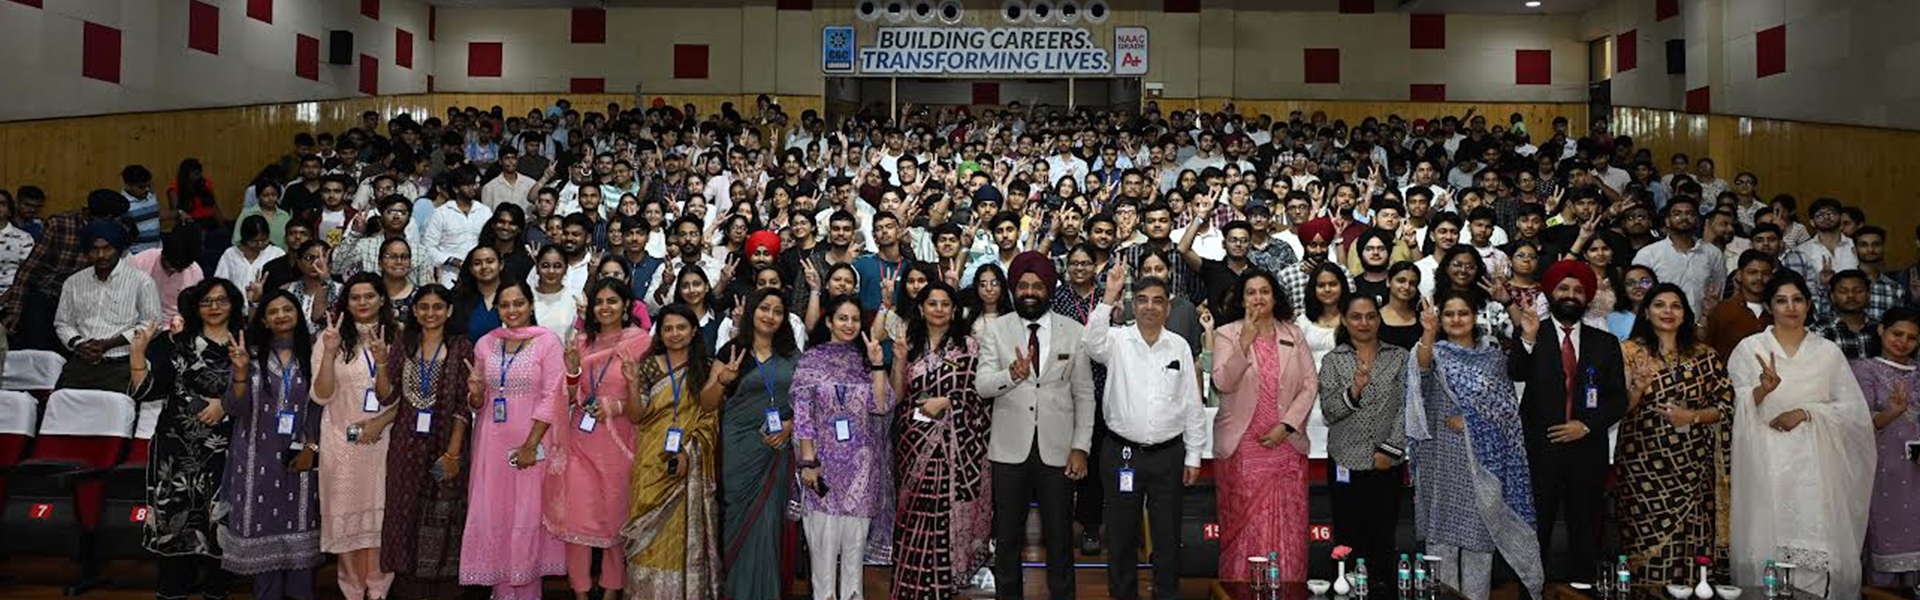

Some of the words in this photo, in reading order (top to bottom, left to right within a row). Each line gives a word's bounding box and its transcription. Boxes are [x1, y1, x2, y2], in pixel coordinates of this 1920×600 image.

[881, 30, 985, 49] BUILDING
[991, 30, 1090, 49] CAREERS.
[1117, 34, 1145, 43] NAAC
[863, 50, 1039, 70] TRANSFORMING
[1044, 51, 1108, 70] LIVES.
[1121, 52, 1142, 67] A+
[38, 504, 48, 518] 7
[136, 507, 147, 521] 8
[1310, 526, 1331, 540] 16
